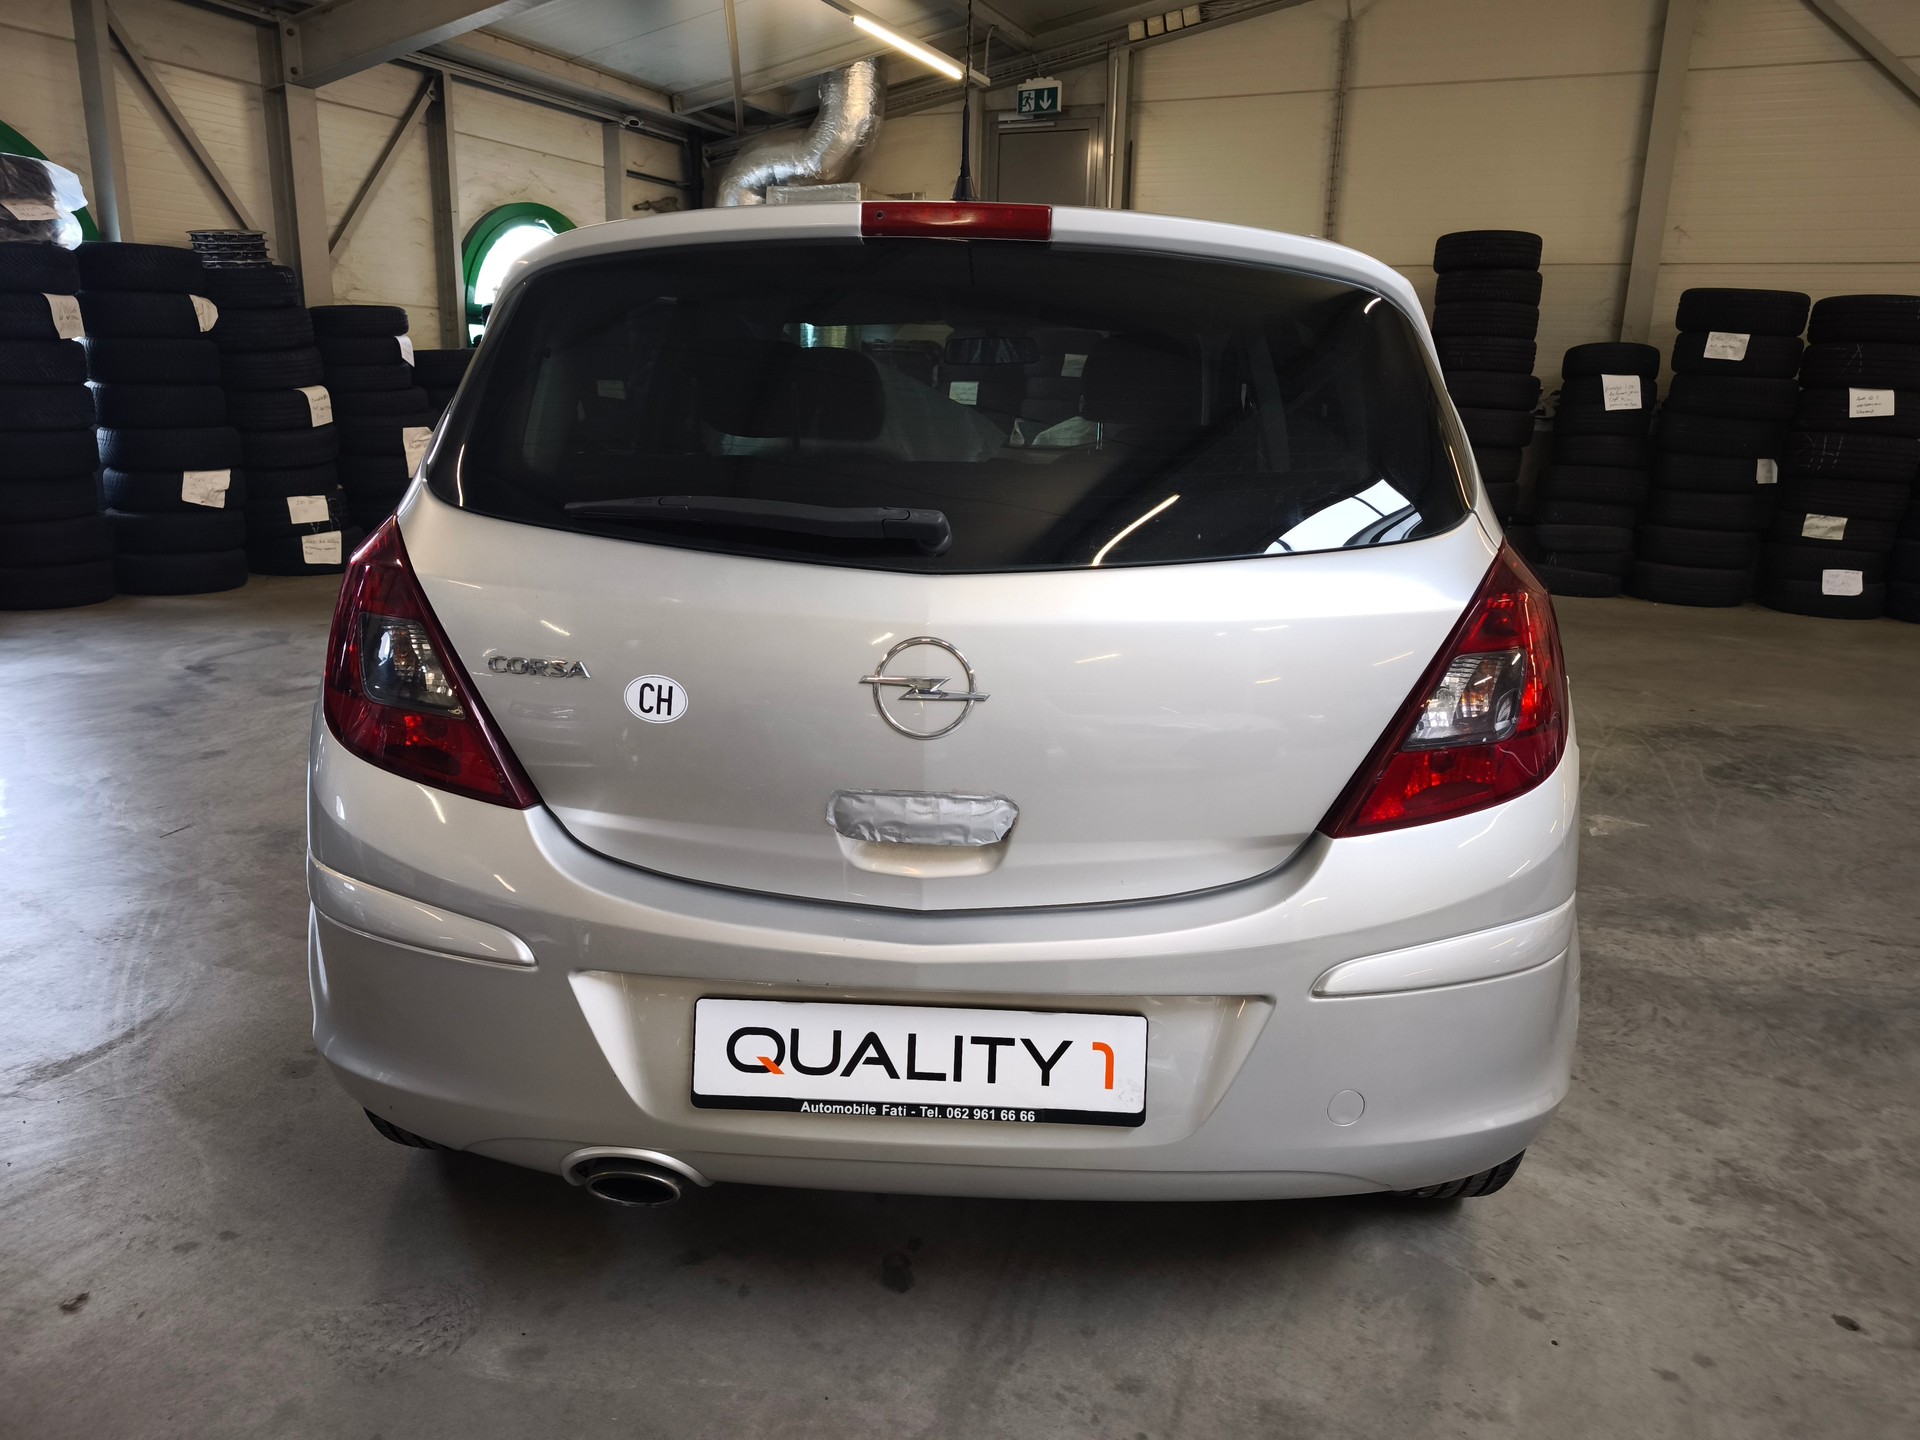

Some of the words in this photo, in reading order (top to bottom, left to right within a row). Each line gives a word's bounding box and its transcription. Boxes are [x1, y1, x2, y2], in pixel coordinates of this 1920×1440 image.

[487, 655, 592, 679] CORSA
[638, 682, 674, 716] CH
[726, 1026, 1074, 1087] QUALITY
[1091, 1041, 1115, 1091] 1
[800, 1101, 877, 1116] Automobile
[882, 1104, 907, 1117] Fati
[919, 1105, 943, 1118] Tel.
[946, 1107, 969, 1119] 062
[973, 1108, 996, 1120] 961
[1000, 1109, 1016, 1121] 66
[1019, 1110, 1036, 1122] 66
